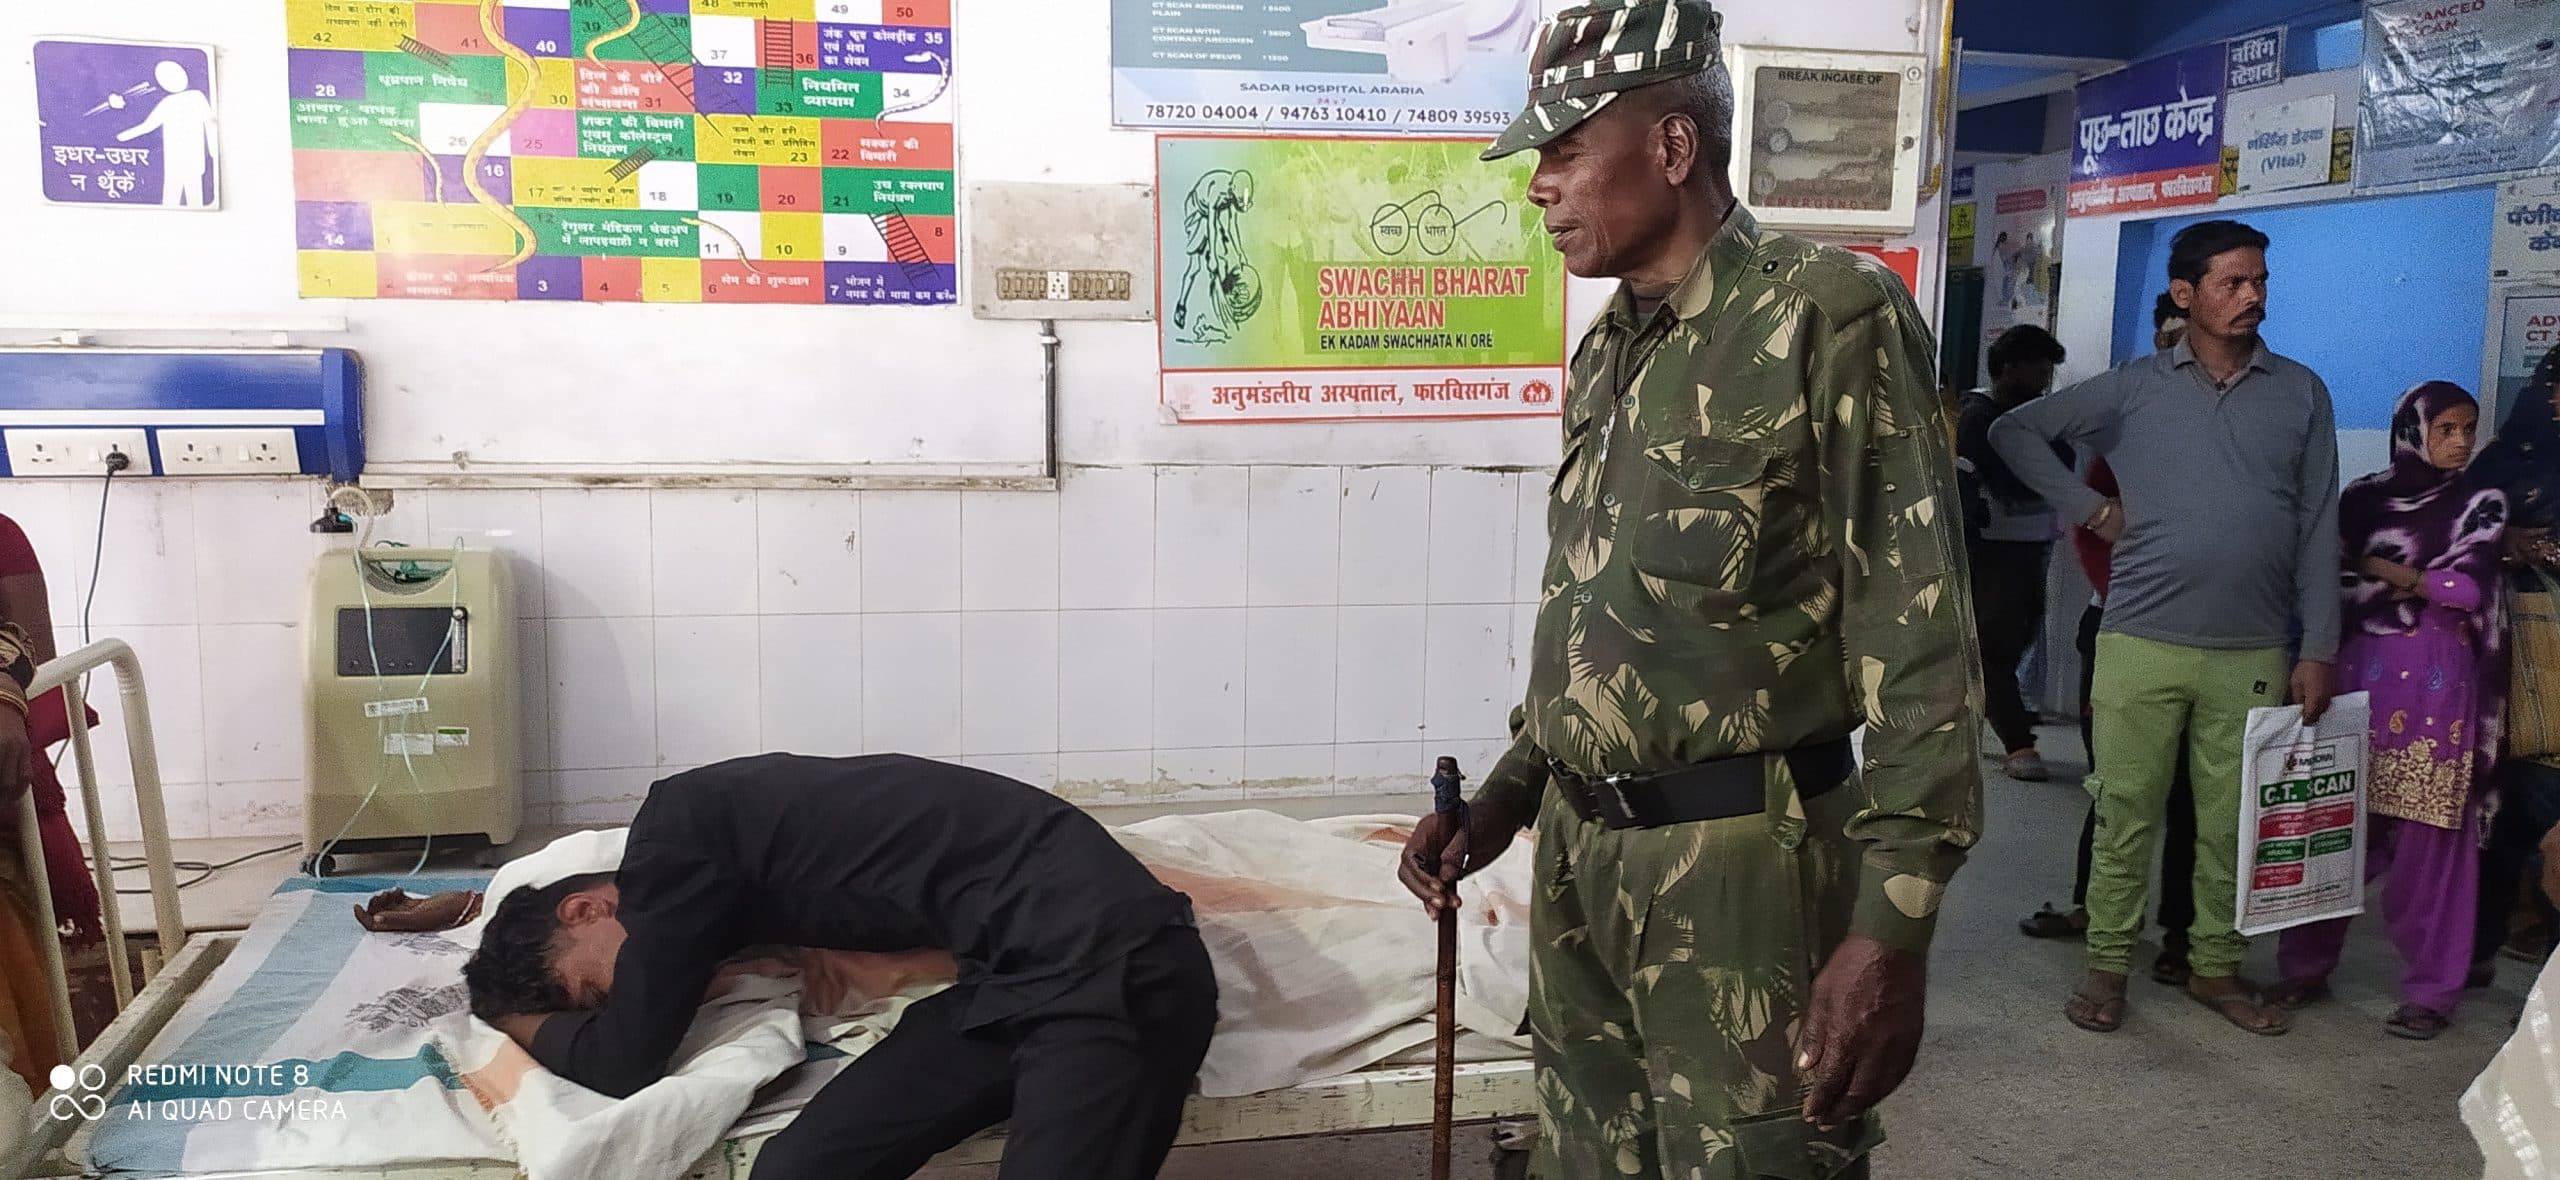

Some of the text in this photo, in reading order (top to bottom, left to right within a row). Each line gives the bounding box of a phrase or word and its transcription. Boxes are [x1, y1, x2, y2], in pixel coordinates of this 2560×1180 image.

[831, 4, 848, 14] 49
[896, 7, 914, 18] 50
[313, 32, 332, 42] 42
[924, 32, 944, 44] 35
[461, 38, 479, 48] 41
[535, 40, 557, 53] 40
[710, 50, 728, 60] 37
[795, 53, 815, 64] 36
[723, 71, 743, 84] 32
[1778, 71, 1819, 82] BREAK
[1867, 74, 1884, 85] OF
[315, 84, 336, 97] 28
[801, 77, 860, 94] नियमित
[1240, 82, 1425, 96] SADAR HOSPITAL ARARIA
[893, 88, 910, 98] 34
[550, 94, 568, 105] 30
[645, 97, 662, 108] 31
[774, 102, 794, 113] 33
[1146, 104, 1512, 125] 78720 04004 / 94763 10410 / 74809 39593
[524, 138, 542, 150] 25
[52, 144, 150, 166] इधर-उधर
[790, 152, 808, 162] 23
[832, 149, 849, 160] 22
[484, 164, 504, 177] 16
[69, 174, 87, 192] न
[528, 188, 544, 198] 17
[649, 192, 668, 202] 18
[717, 194, 734, 204] 19
[777, 194, 796, 205] 20
[832, 196, 849, 206] 21
[934, 226, 944, 237] 8
[1424, 225, 1447, 238] भारत
[324, 234, 346, 246] 14
[2528, 230, 2560, 252] के
[704, 243, 720, 254] 11
[776, 244, 793, 256] 10
[838, 246, 847, 256] 9
[537, 280, 548, 292] 3
[600, 282, 608, 292] 4
[1318, 266, 1530, 298] SWACHH BHARAT
[662, 284, 670, 293] 5
[708, 284, 718, 294] 6
[830, 285, 840, 296] 7
[1317, 300, 1446, 330] ABHIYAAN
[2526, 314, 2560, 327] AD
[2526, 330, 2552, 341] CT
[1320, 336, 1336, 350] EK
[1340, 335, 1380, 349] KADAM
[1383, 334, 1453, 349] SWACHHATA
[1456, 334, 1467, 348] KI
[1212, 381, 1311, 411] अनुमंडलीय
[1321, 382, 1403, 406] अस्पताल,
[1412, 378, 1511, 402] फारबिसगंज
[2264, 774, 2352, 804] C.T. SCAN
